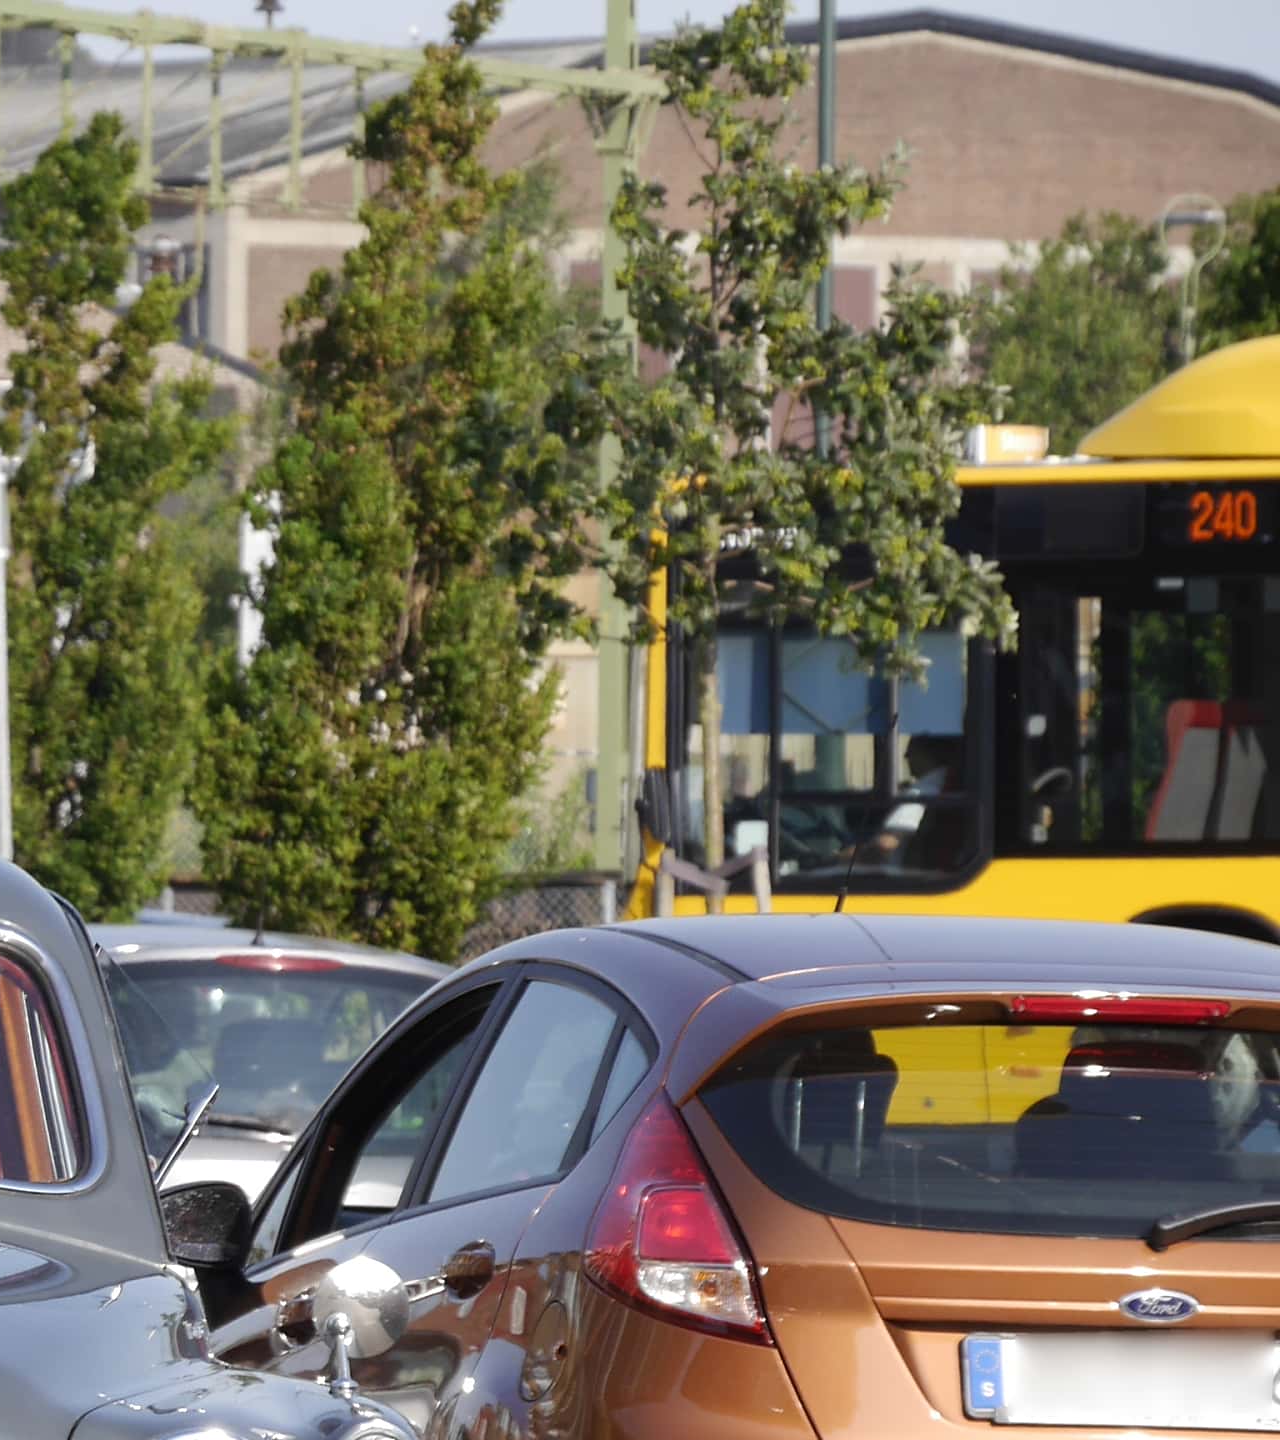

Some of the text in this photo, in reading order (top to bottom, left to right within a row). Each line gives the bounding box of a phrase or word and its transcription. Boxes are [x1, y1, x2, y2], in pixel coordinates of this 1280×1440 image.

[1189, 491, 1258, 542] 240
[1138, 1294, 1184, 1315] Ford
[981, 1381, 996, 1398] S
